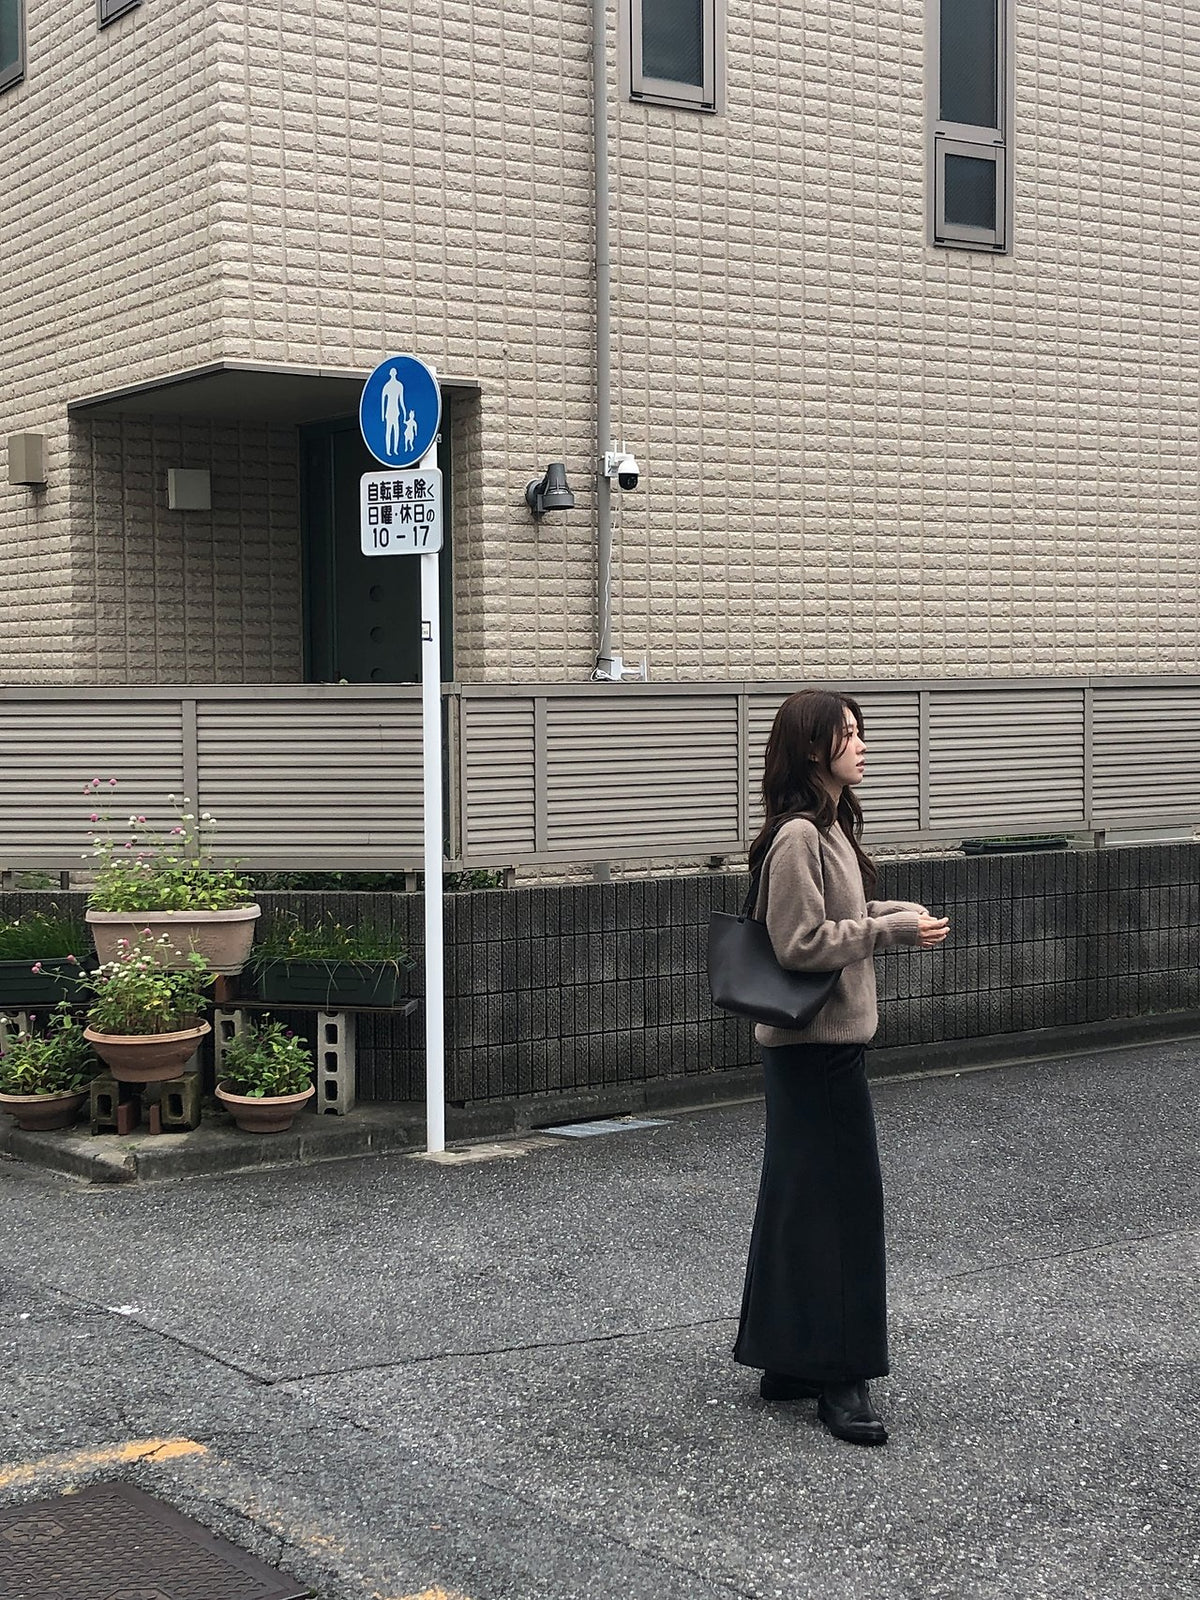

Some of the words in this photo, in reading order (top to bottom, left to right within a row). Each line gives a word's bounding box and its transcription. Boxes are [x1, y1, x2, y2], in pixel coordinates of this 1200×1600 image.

[368, 478, 435, 501] 自転車を除く
[368, 503, 435, 525] 日曜・休日の
